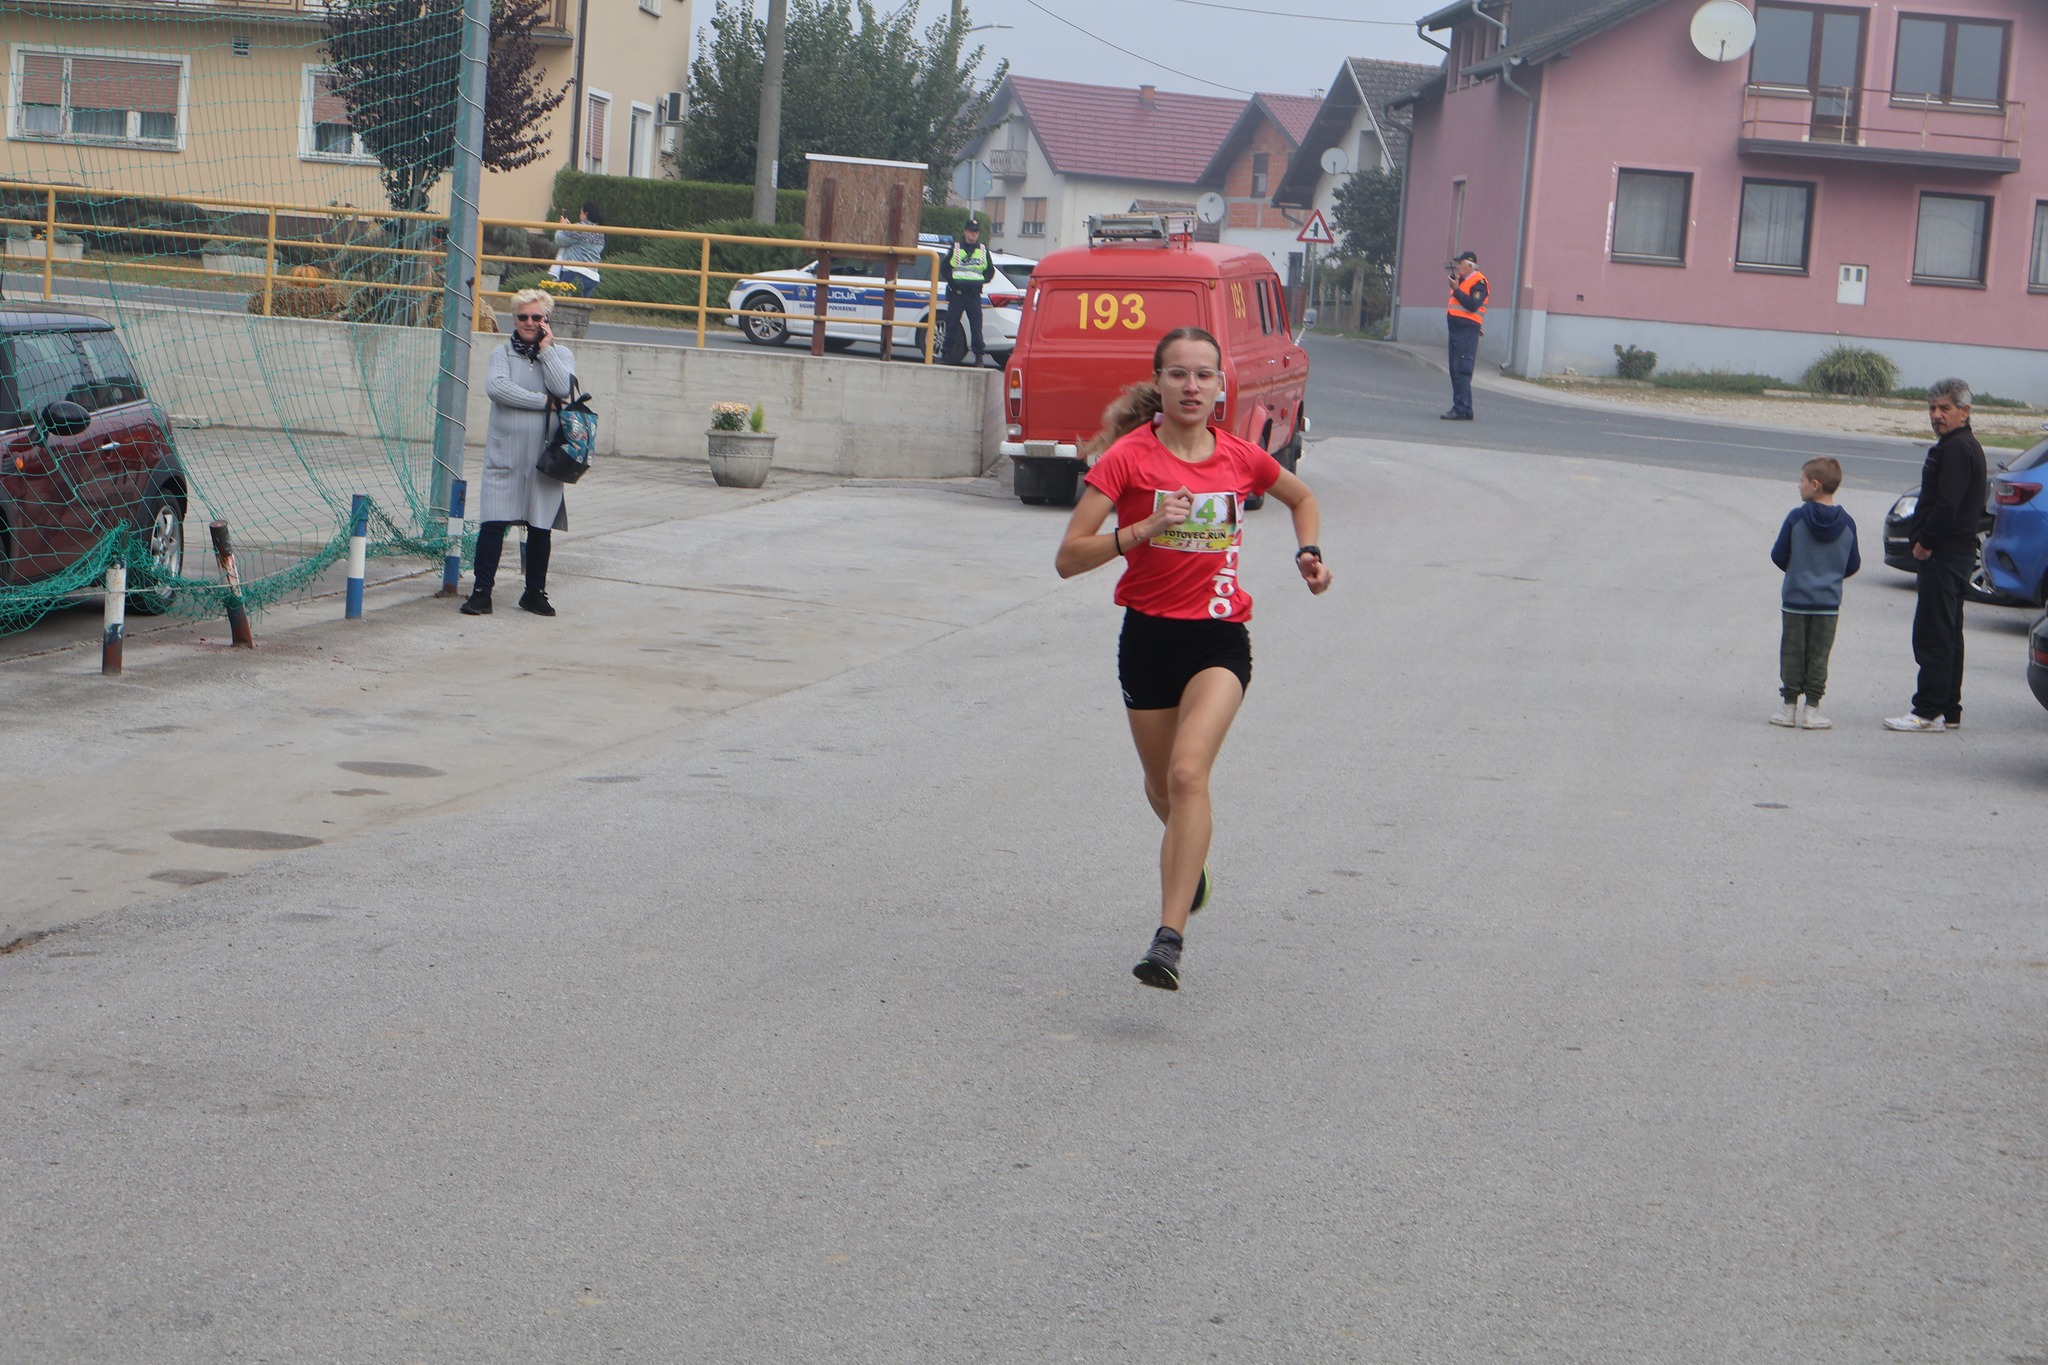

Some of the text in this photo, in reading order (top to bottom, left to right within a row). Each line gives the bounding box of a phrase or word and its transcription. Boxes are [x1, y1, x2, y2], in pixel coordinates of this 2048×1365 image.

[812, 290, 857, 301] PLICIJA
[1077, 292, 1147, 330] 193
[1230, 281, 1246, 319] 193
